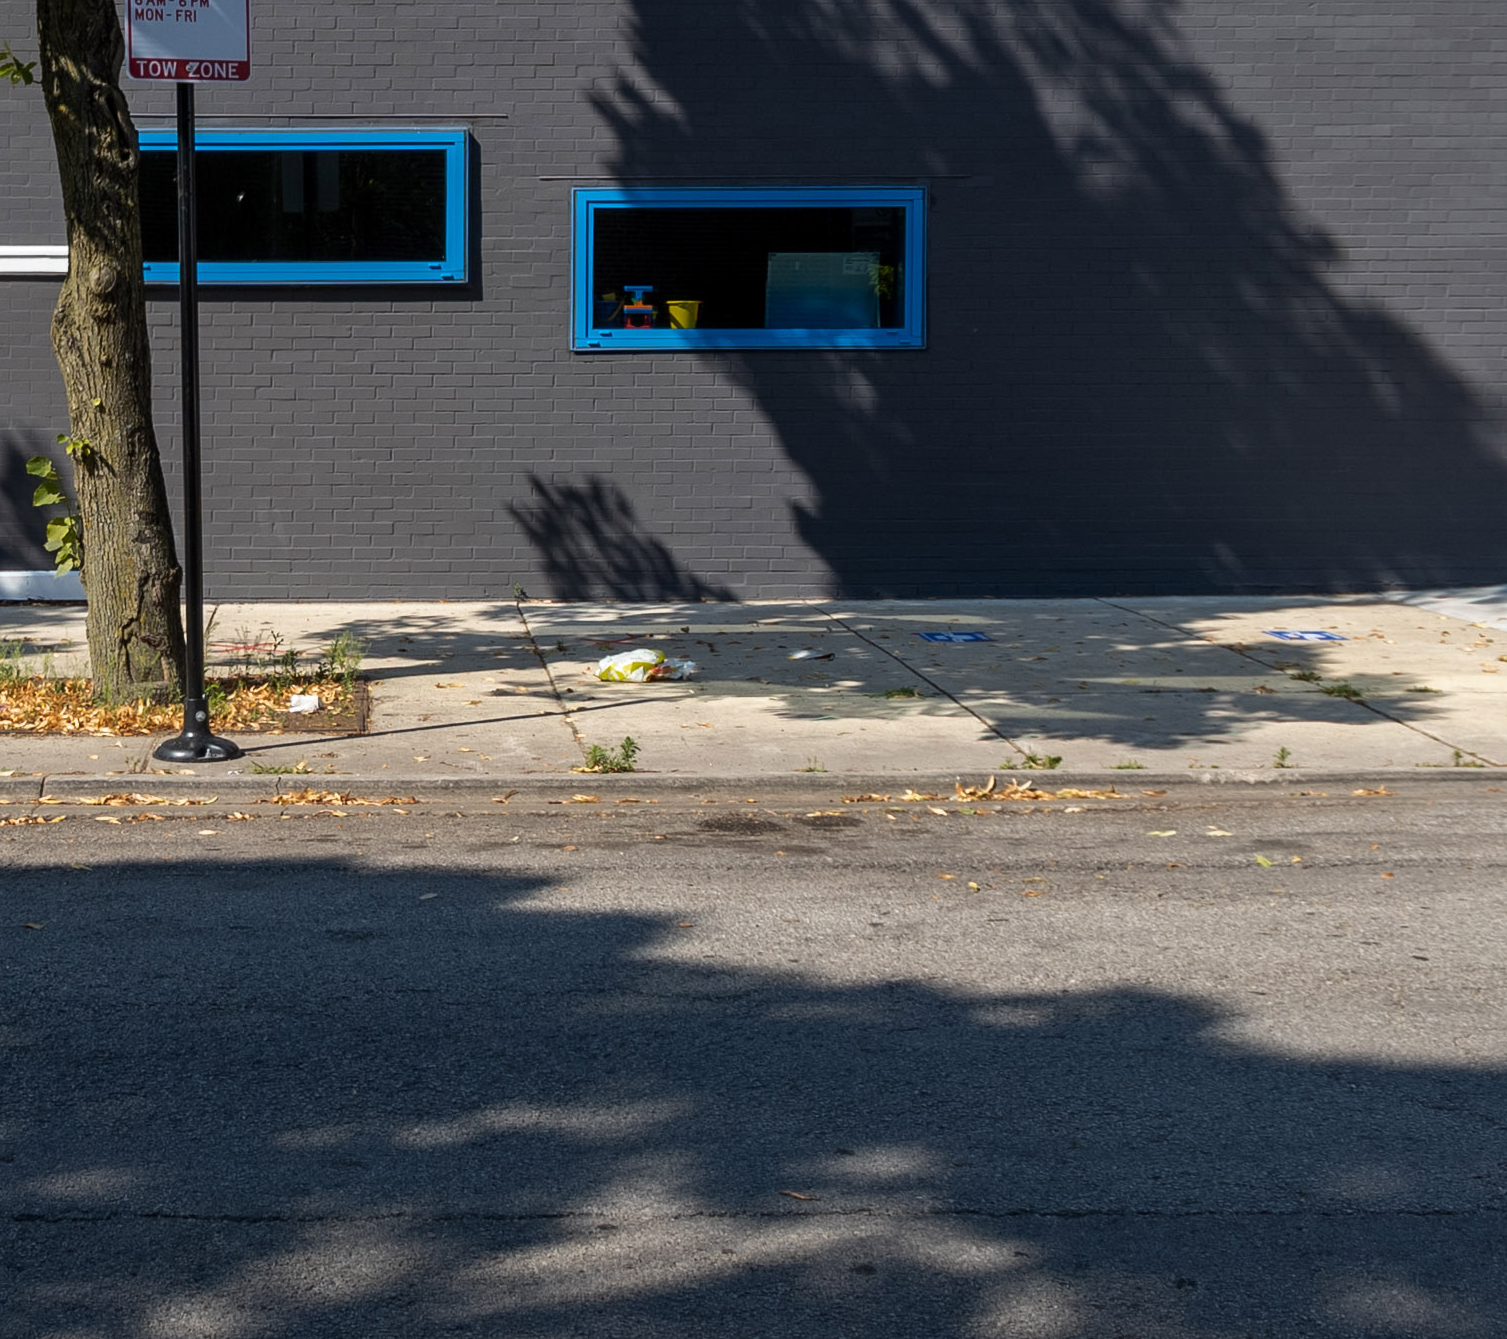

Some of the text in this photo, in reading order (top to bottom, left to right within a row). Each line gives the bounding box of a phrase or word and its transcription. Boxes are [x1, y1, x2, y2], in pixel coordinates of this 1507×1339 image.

[134, 8, 164, 22] MON
[175, 9, 197, 23] FRI
[136, 60, 240, 79] TOW ZONE
